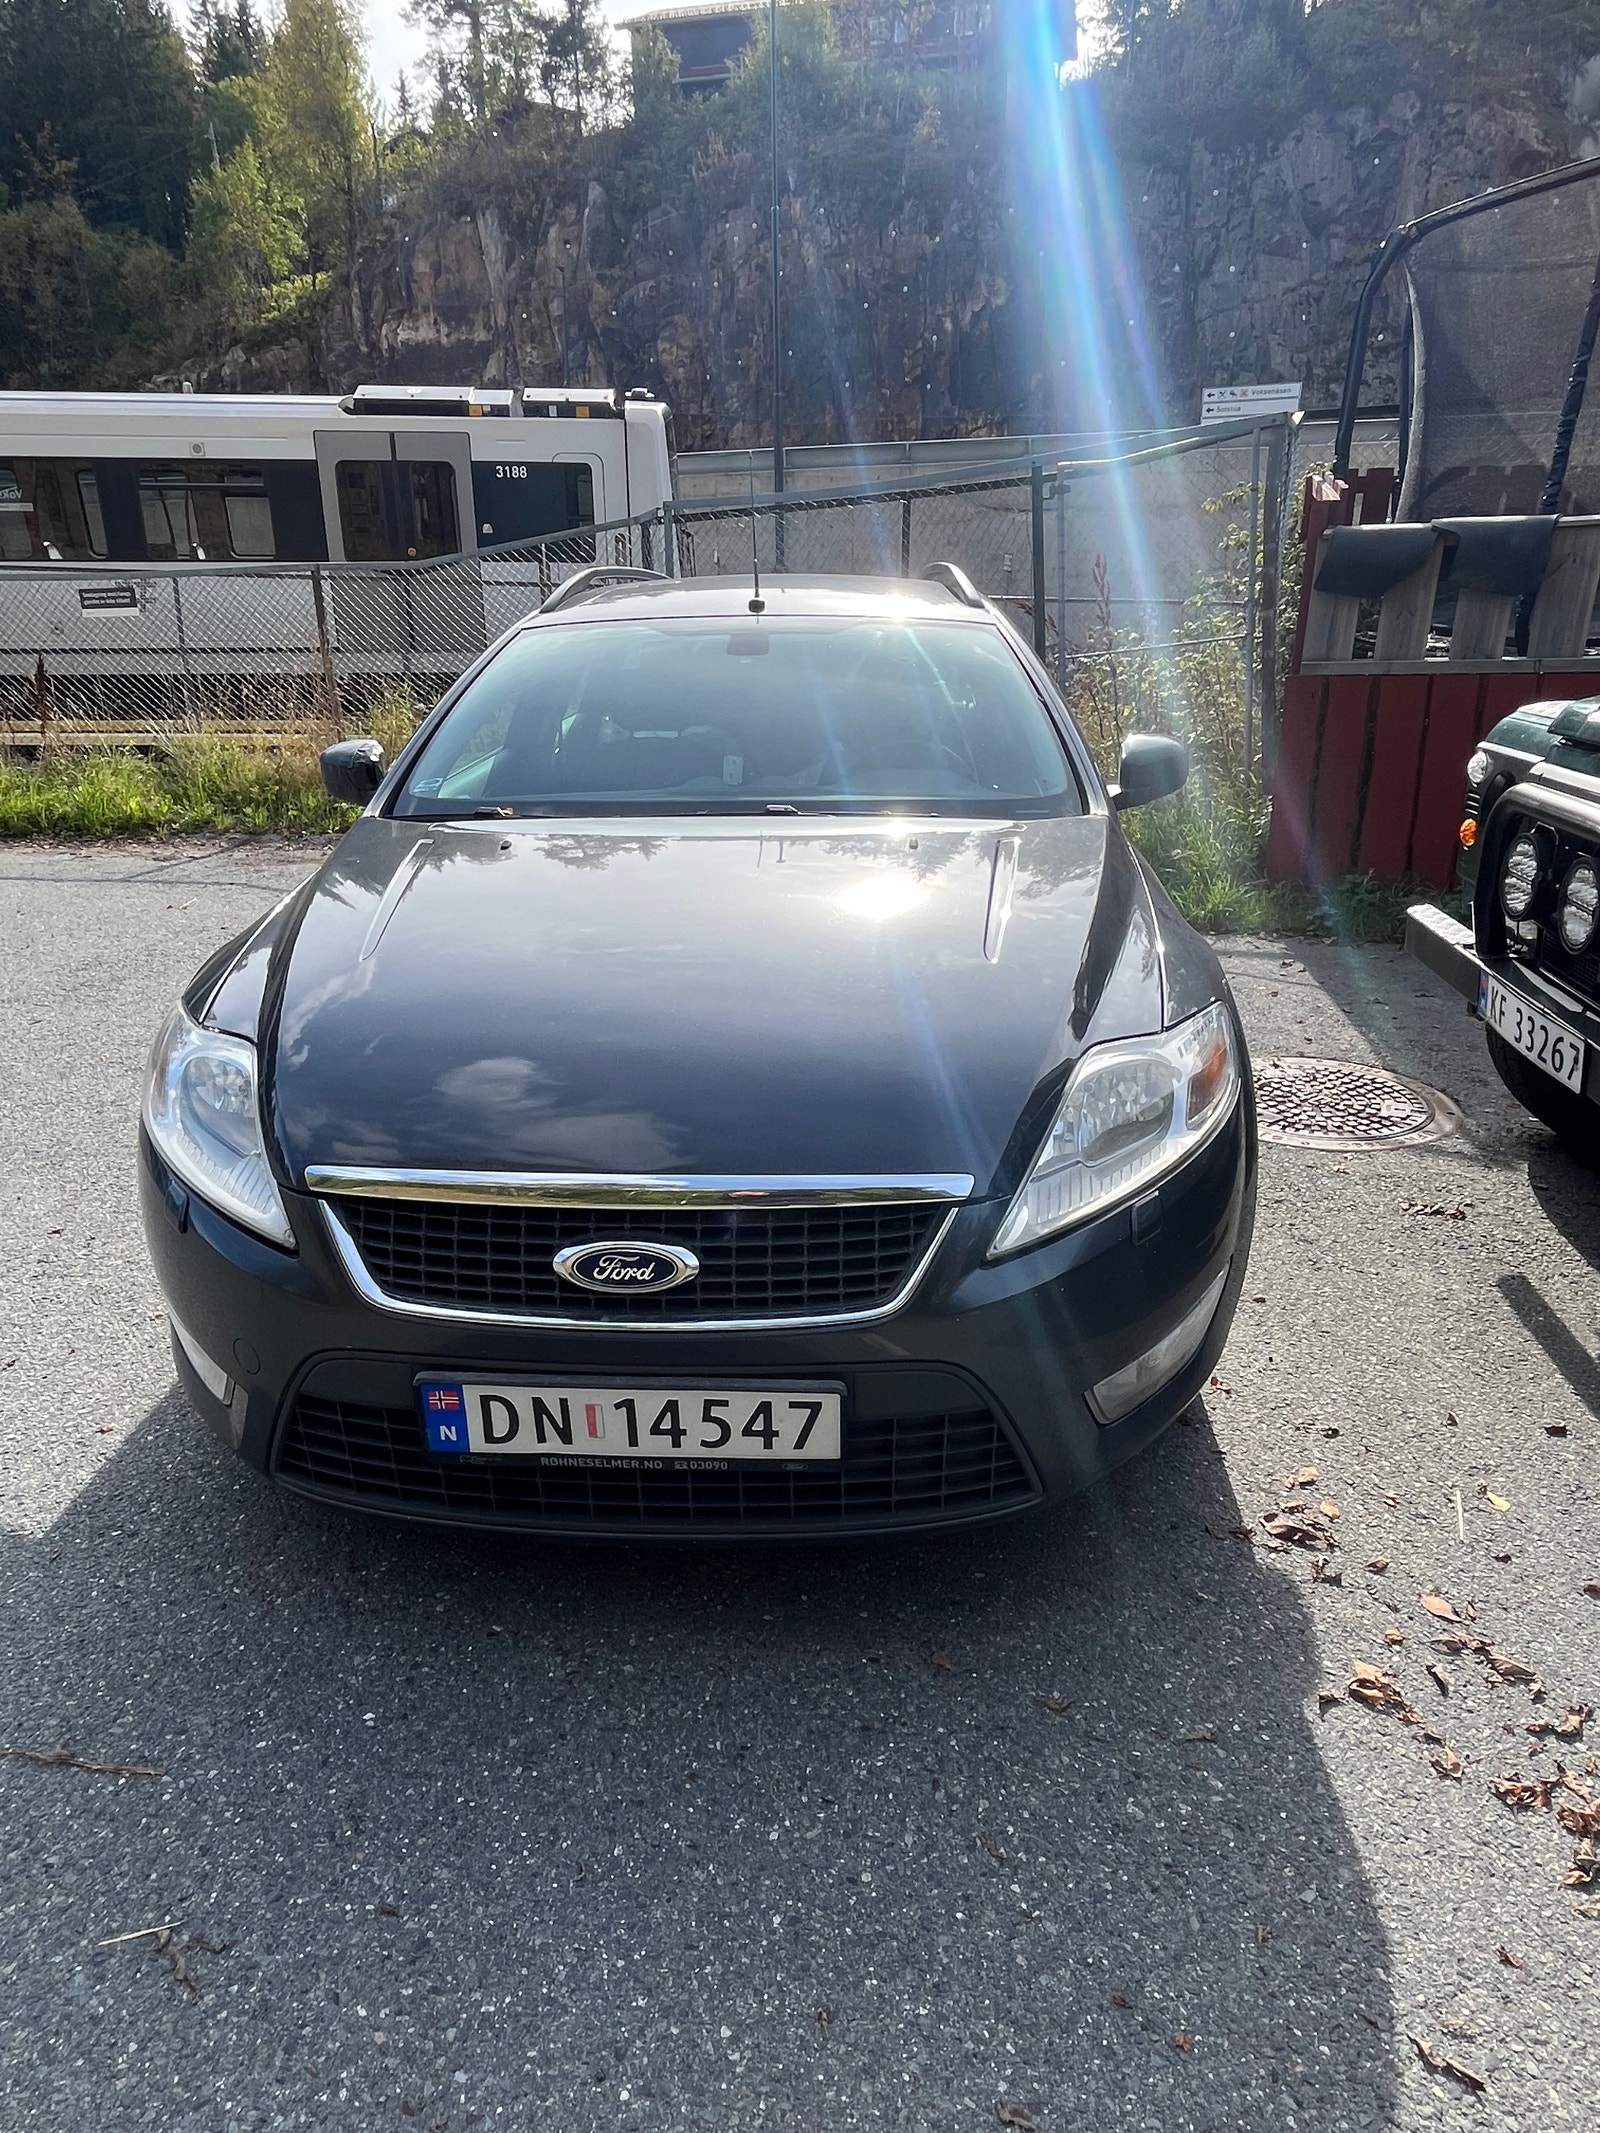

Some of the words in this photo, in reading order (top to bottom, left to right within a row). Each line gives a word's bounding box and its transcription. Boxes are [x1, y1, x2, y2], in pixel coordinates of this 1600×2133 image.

[495, 465, 528, 478] 3188
[1490, 986, 1507, 1028] KF
[1514, 1007, 1580, 1081] 33267
[593, 1254, 655, 1281] Ford
[479, 1394, 573, 1446] DN
[613, 1398, 823, 1450] 14547
[440, 1425, 457, 1441] N
[689, 1461, 728, 1470] 03090
